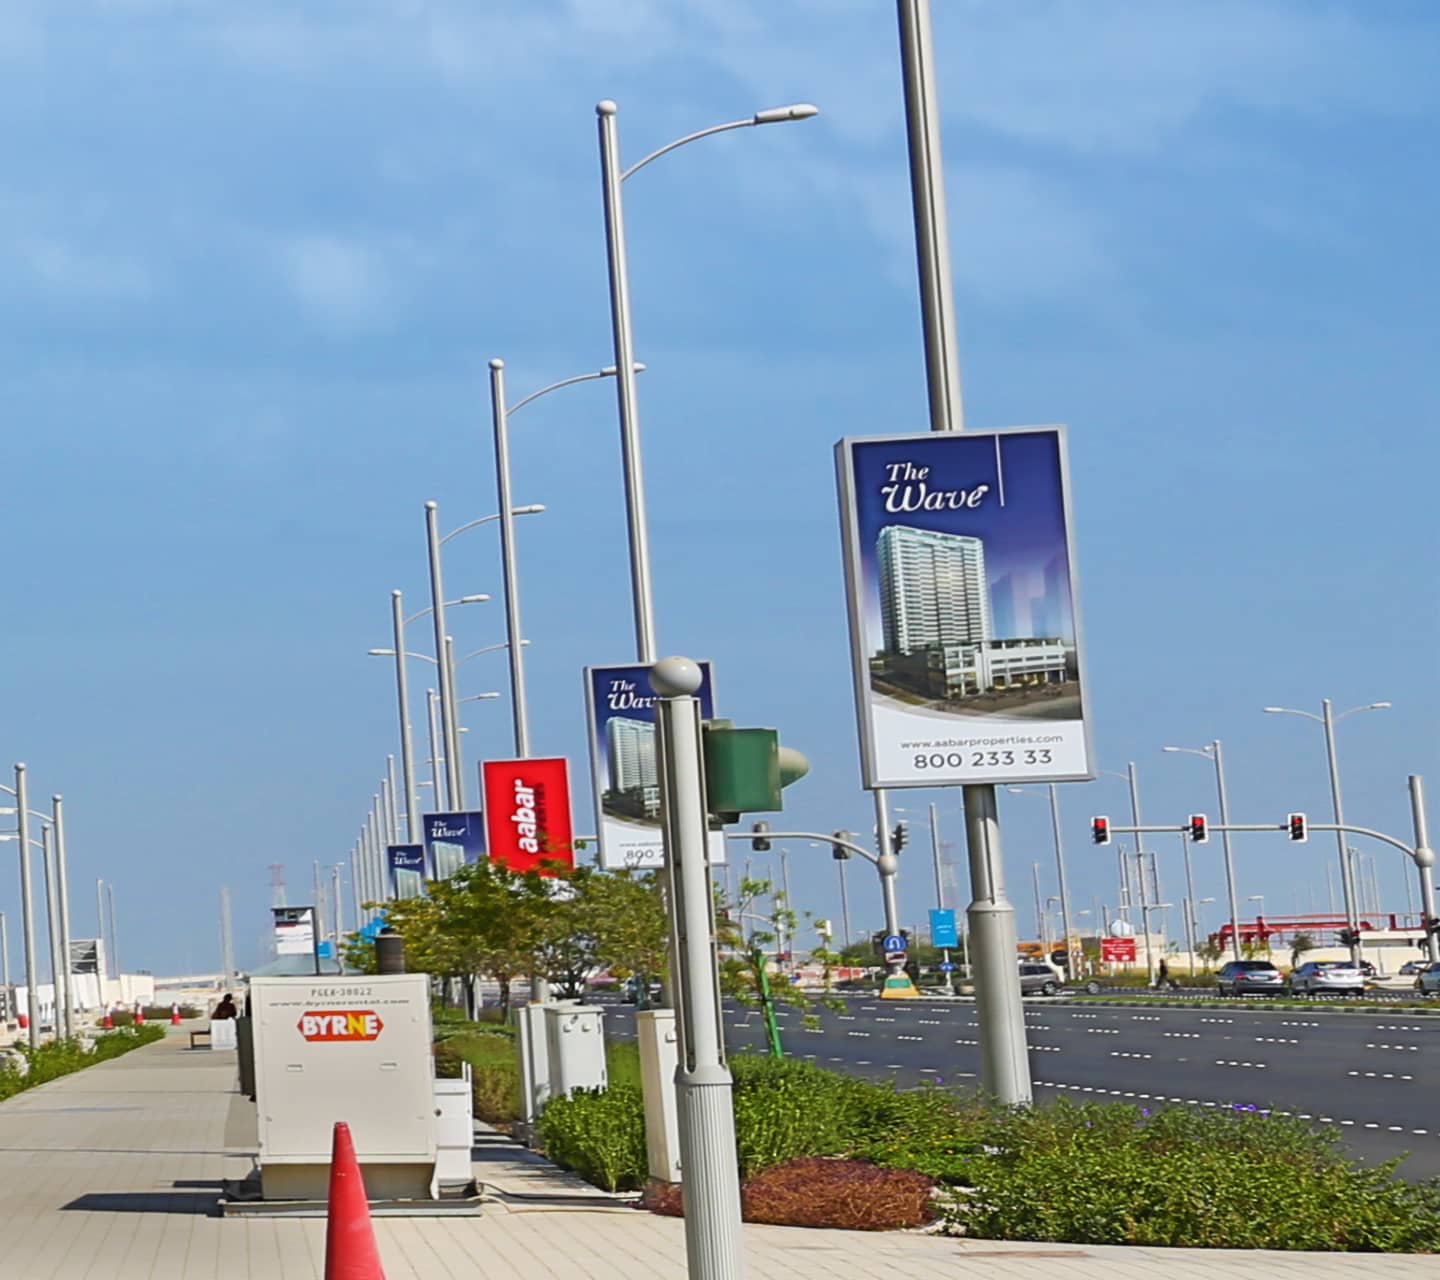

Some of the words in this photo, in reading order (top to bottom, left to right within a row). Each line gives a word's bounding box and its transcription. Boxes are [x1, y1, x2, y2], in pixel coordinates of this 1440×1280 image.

[885, 461, 929, 481] The
[880, 482, 989, 512] Wave
[609, 680, 636, 691] The
[900, 734, 1064, 750] www.aabarproperties.com
[913, 753, 963, 769] 800
[971, 750, 1015, 767] 233
[1023, 748, 1053, 765] 33
[511, 779, 539, 853] aabar
[626, 849, 654, 860] 800
[303, 1013, 378, 1037] BYRNE
